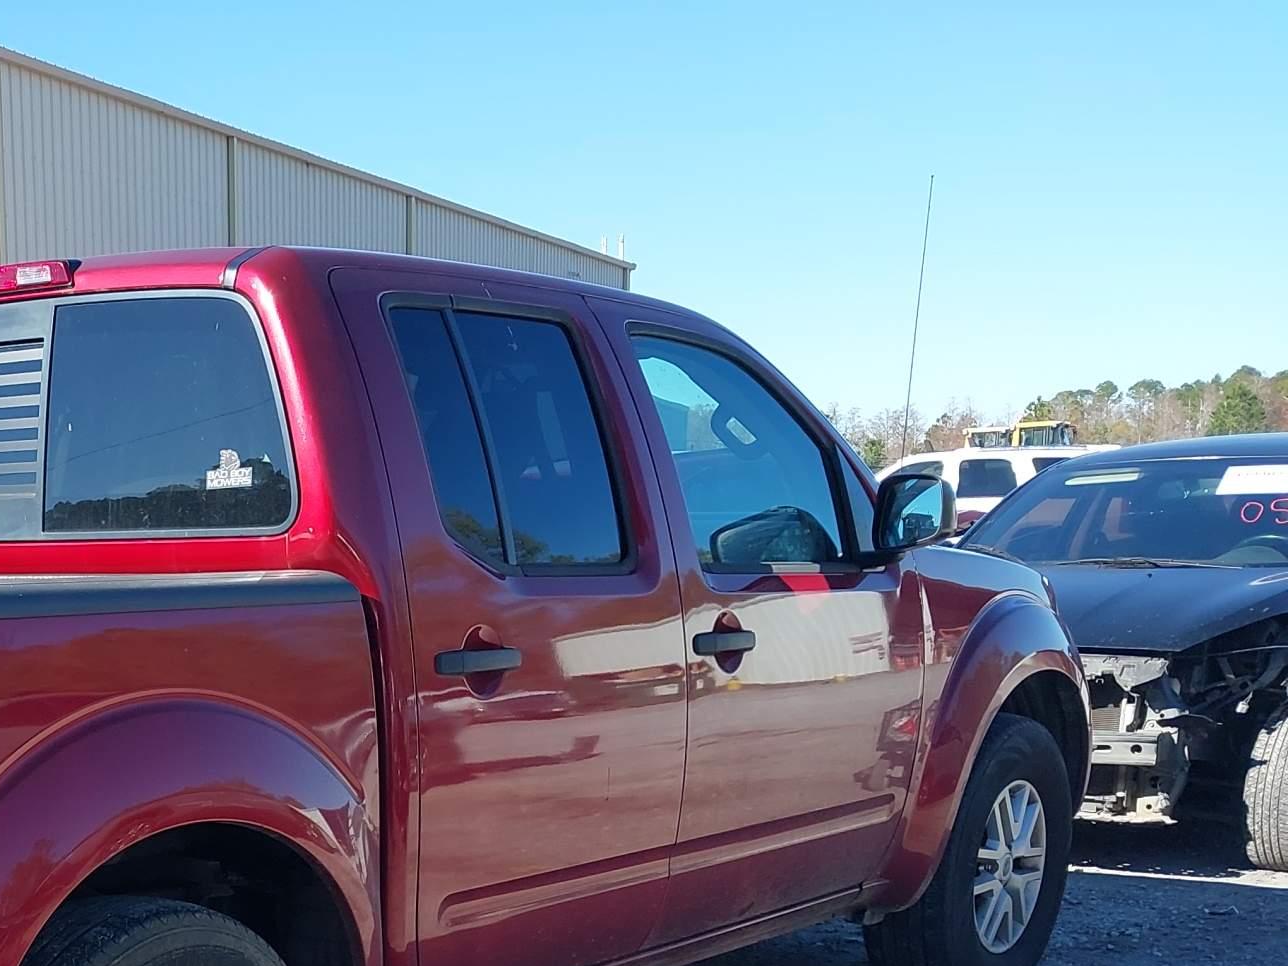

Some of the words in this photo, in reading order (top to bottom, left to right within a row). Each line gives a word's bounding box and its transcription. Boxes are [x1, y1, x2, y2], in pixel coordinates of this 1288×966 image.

[208, 470, 228, 479] BAD
[230, 468, 251, 478] BOY
[207, 477, 252, 488] MOWERS
